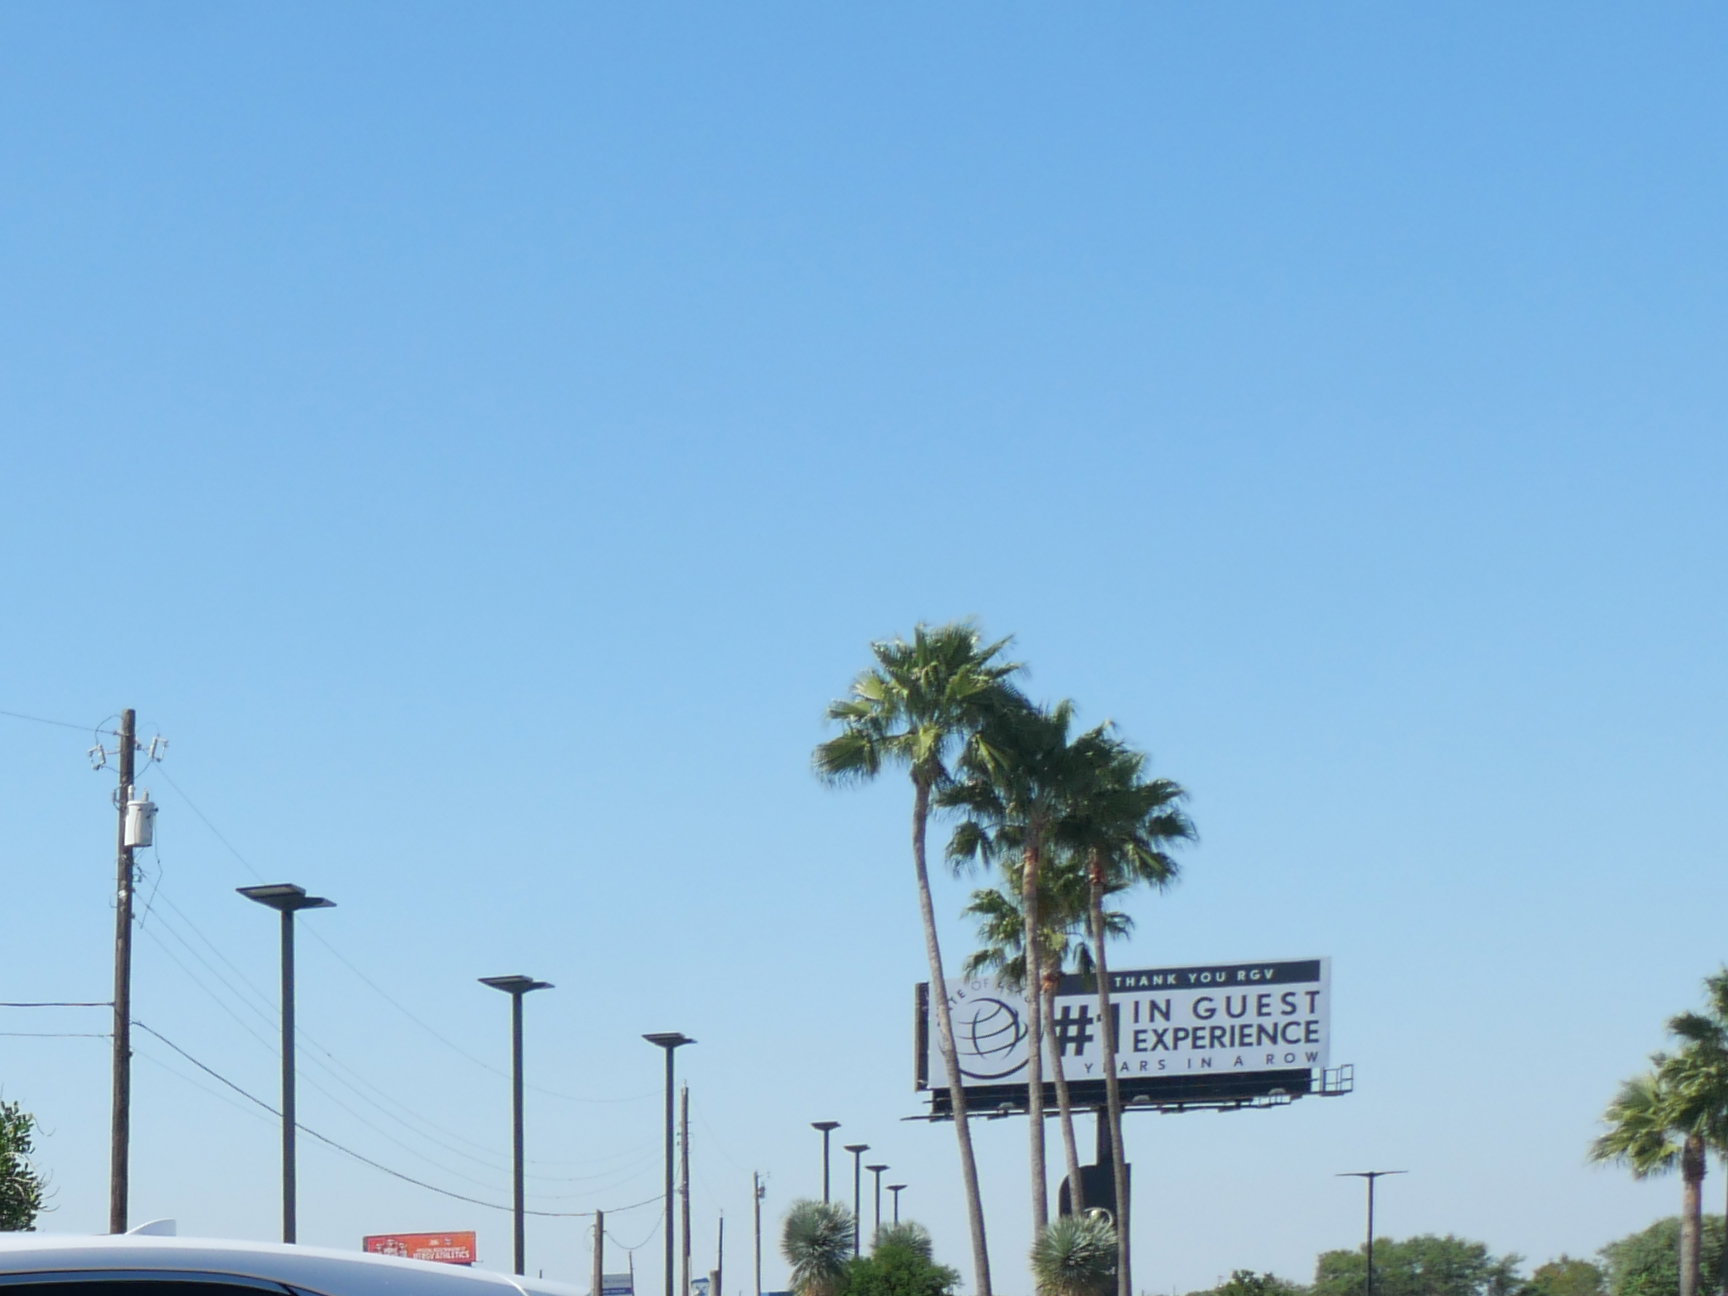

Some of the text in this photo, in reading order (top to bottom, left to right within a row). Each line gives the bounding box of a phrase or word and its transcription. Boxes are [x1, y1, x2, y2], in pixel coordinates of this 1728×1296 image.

[1114, 968, 1274, 987] THANK YOU RGV
[1133, 990, 1320, 1024] IN GUEST
[1133, 1020, 1320, 1053] EXPERIENCE
[1084, 1051, 1319, 1074] YARS IN A ROW
